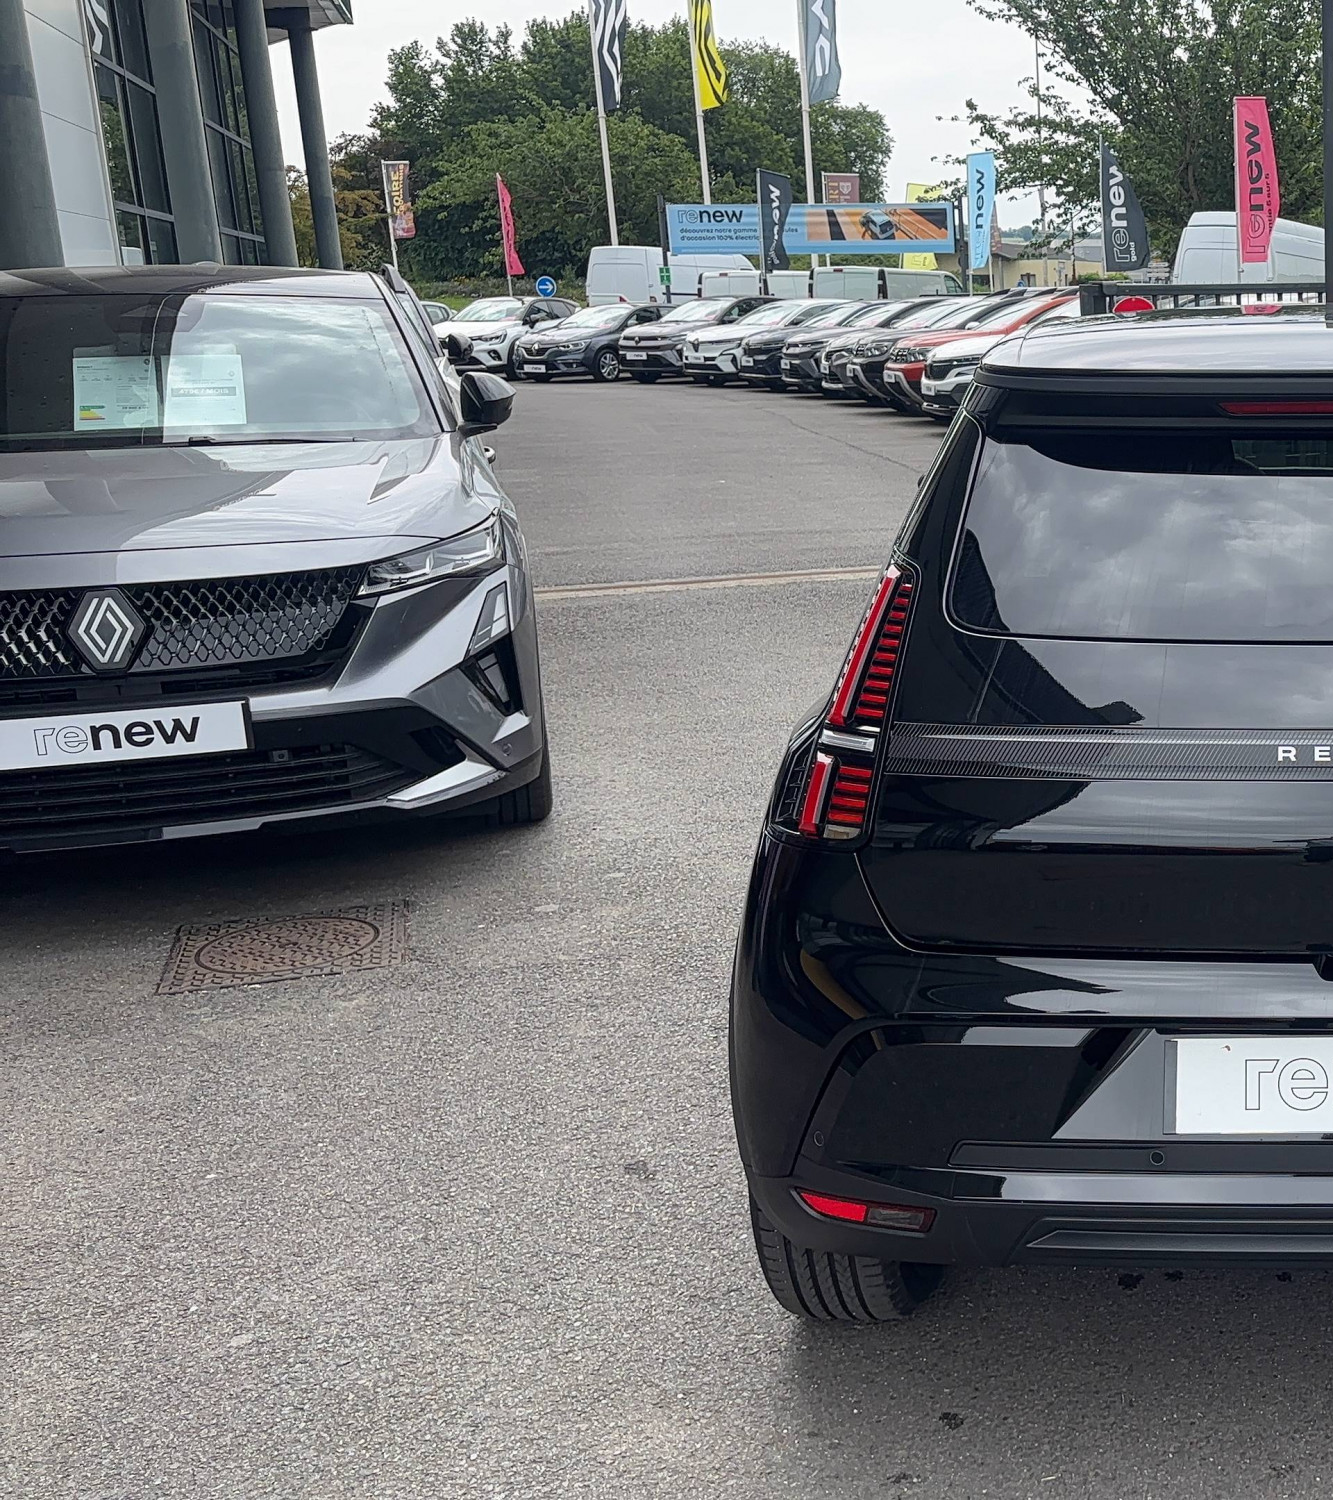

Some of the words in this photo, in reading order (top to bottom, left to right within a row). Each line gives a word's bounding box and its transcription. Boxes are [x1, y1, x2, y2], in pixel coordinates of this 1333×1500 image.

[1244, 120, 1266, 254] renew
[678, 209, 744, 224] renew
[1129, 241, 1138, 262] gold
[33, 716, 201, 756] renew
